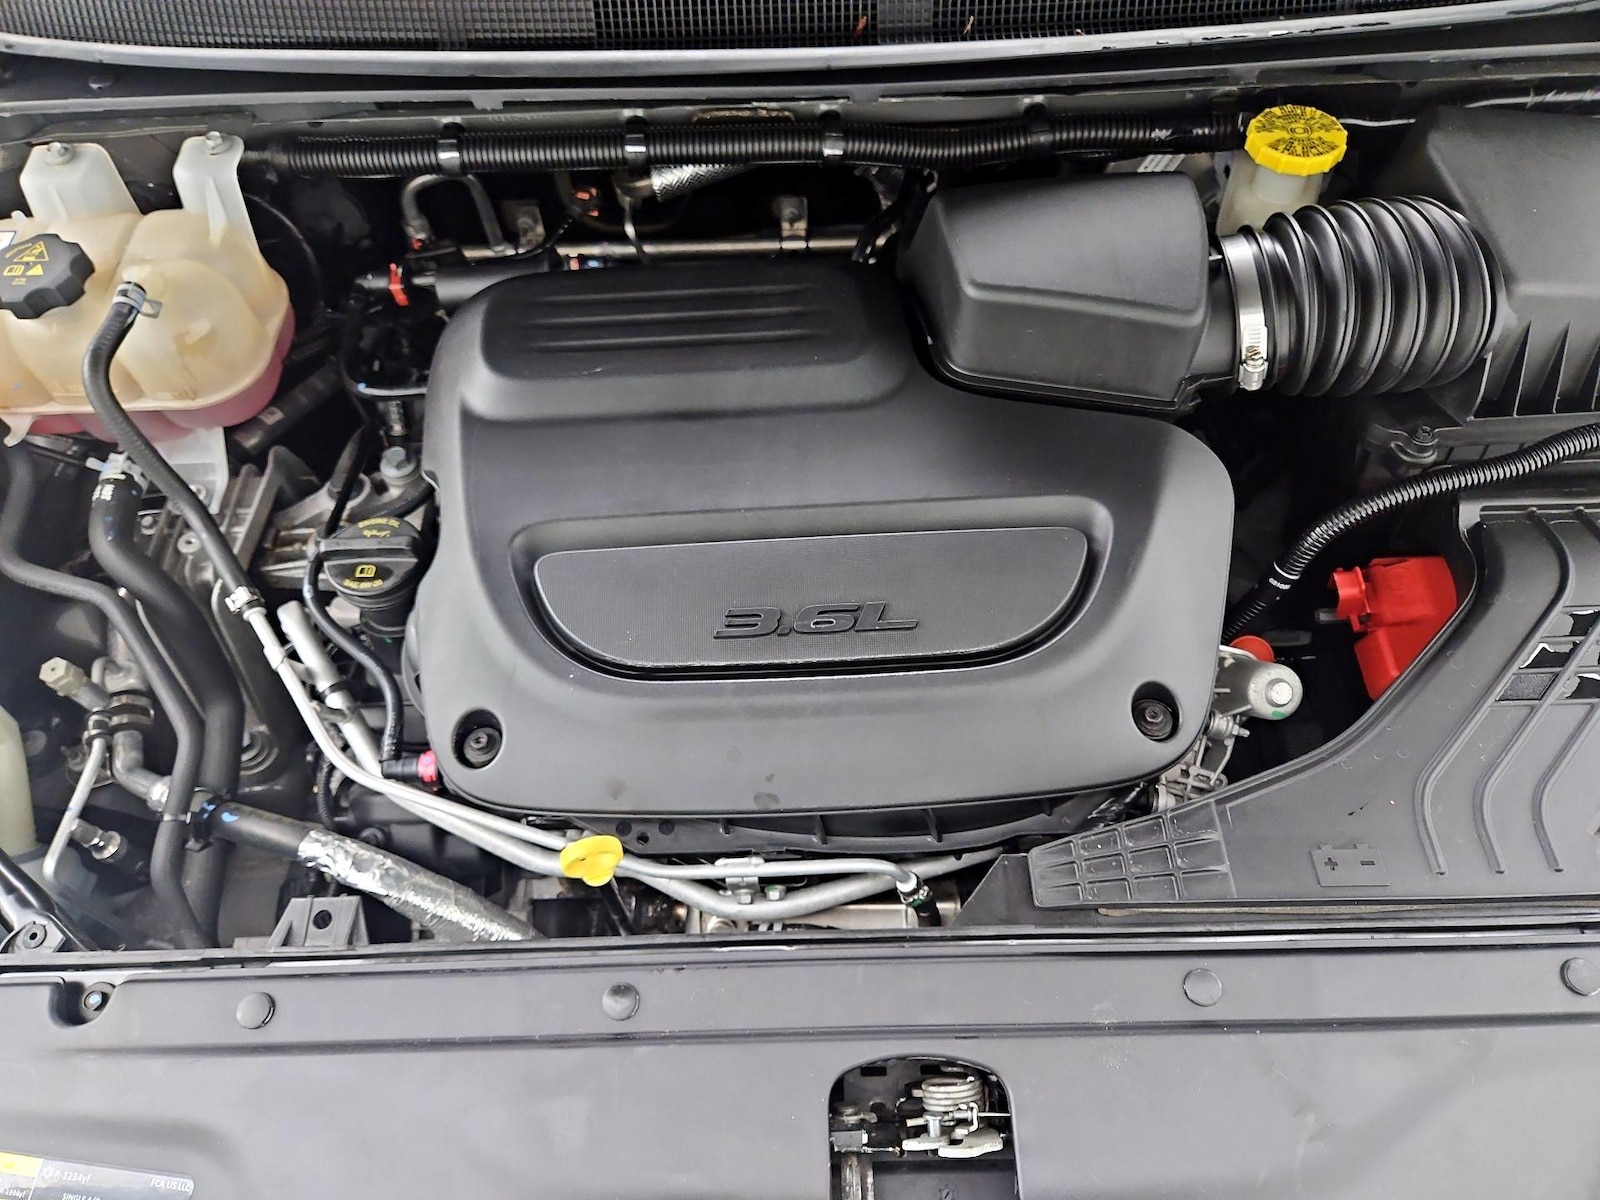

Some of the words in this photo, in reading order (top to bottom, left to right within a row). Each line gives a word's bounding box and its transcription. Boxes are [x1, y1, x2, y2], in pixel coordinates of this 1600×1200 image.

[389, 519, 401, 529] OIL
[713, 601, 918, 639] 3.6L
[54, 1171, 92, 1184] R-1234yf
[151, 1178, 165, 1188] FCA
[166, 1180, 178, 1190] US
[178, 1182, 192, 1192] LLC
